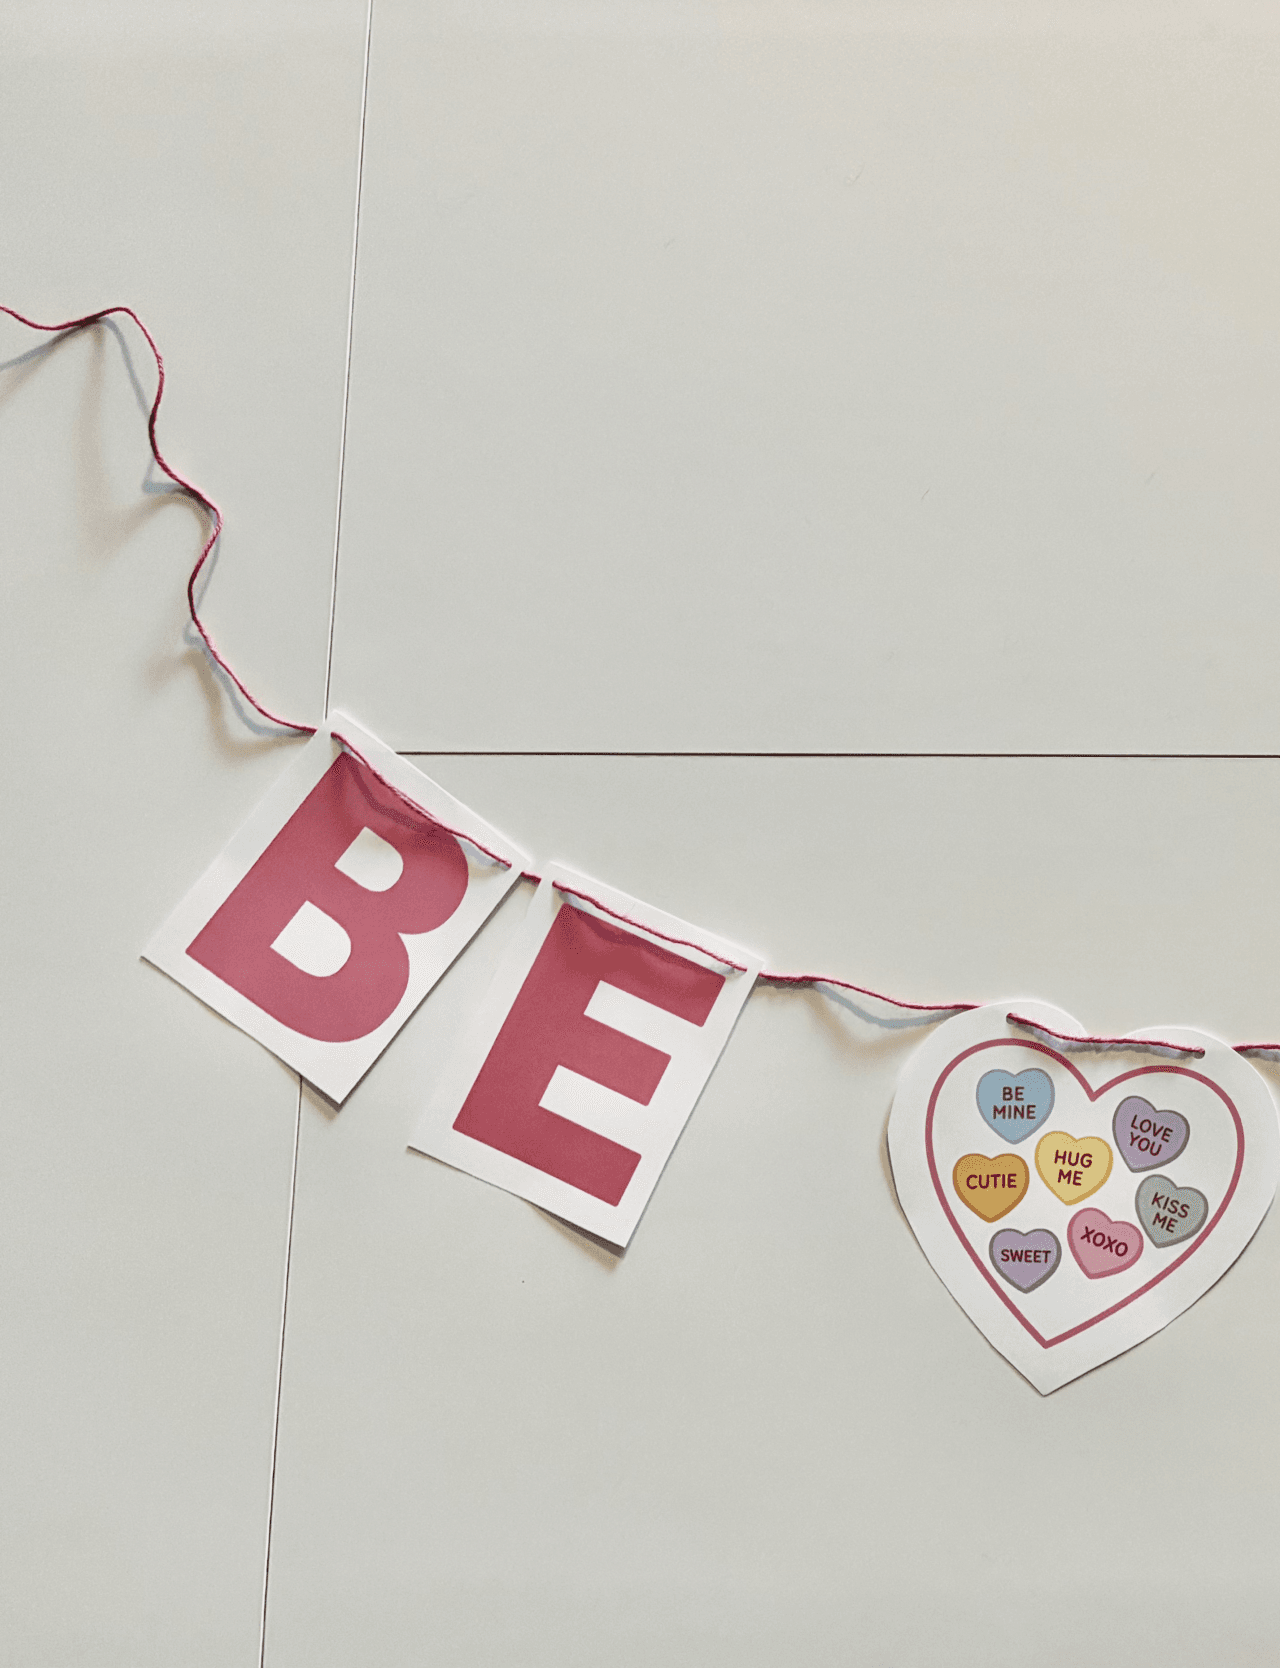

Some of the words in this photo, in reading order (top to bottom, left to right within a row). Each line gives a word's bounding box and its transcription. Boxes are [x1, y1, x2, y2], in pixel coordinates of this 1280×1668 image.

[185, 751, 726, 1207] BE
[1002, 1086, 1025, 1102] BE
[992, 1104, 1037, 1120] MINE
[1130, 1114, 1173, 1144] LOVE
[1129, 1132, 1162, 1157] YOU
[1053, 1150, 1093, 1169] HUG
[965, 1173, 1017, 1190] CUTIE
[1057, 1169, 1083, 1186] ME
[1151, 1192, 1190, 1219] KISS
[1152, 1212, 1178, 1233] ME
[1080, 1226, 1129, 1257] XOXO
[1000, 1249, 1051, 1264] SWEET
